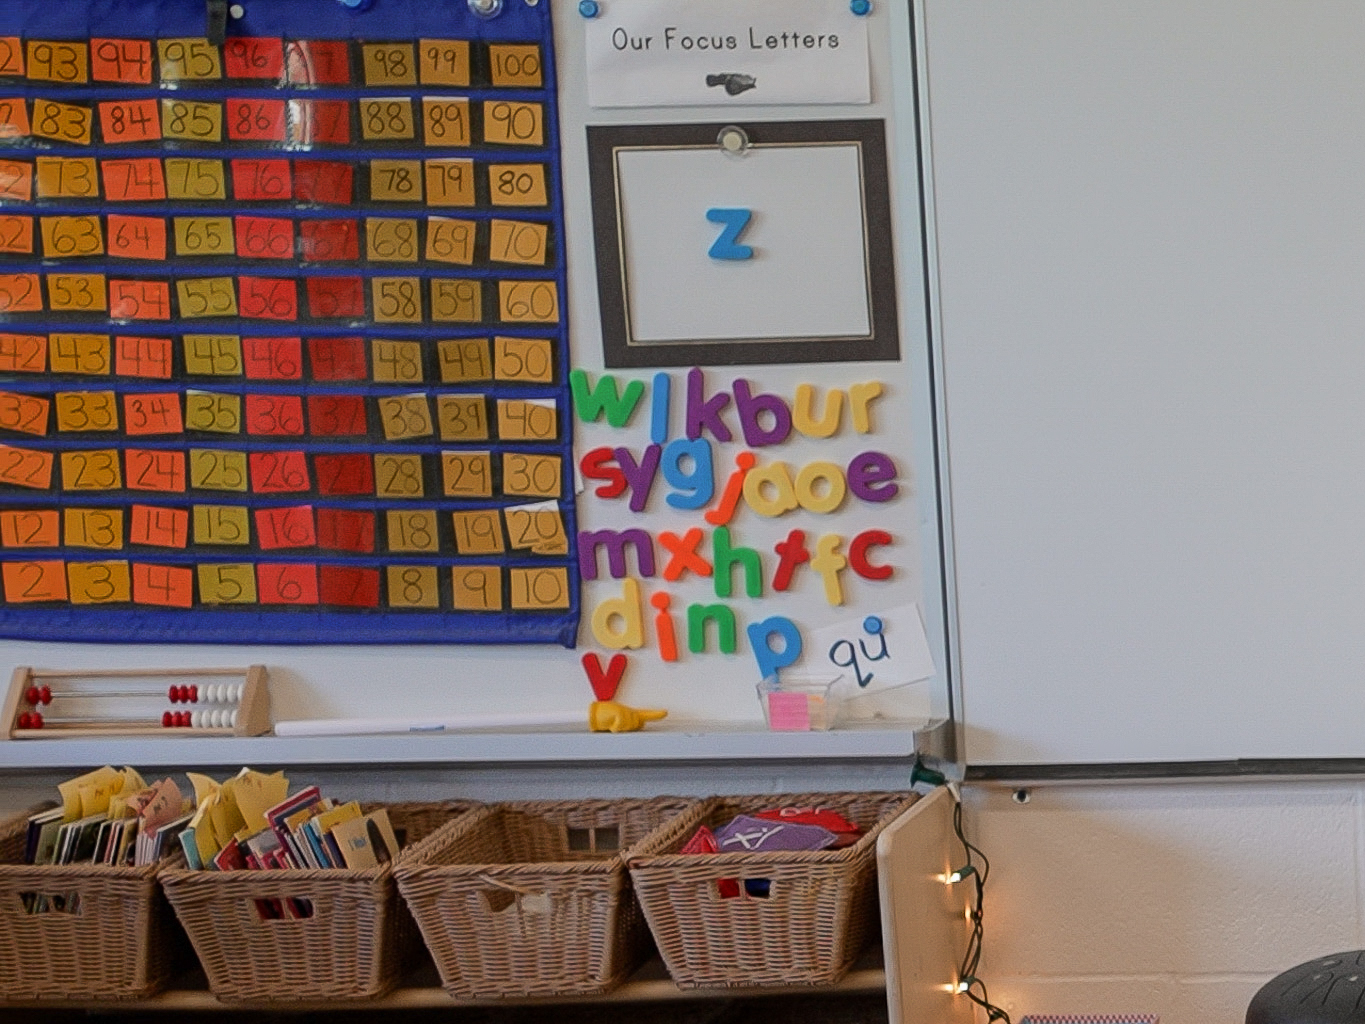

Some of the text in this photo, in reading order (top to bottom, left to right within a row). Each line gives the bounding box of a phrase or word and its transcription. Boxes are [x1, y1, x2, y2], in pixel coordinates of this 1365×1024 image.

[612, 27, 839, 50] Our Focus Letters
[0, 41, 18, 73] 2
[34, 45, 78, 80] 93
[97, 42, 147, 78] 94
[165, 42, 213, 76] 95
[228, 44, 267, 69] 96
[375, 49, 407, 76] 98
[428, 49, 456, 72] 99
[496, 52, 538, 76] 100
[42, 104, 86, 140] 83
[111, 105, 151, 135] 84
[171, 105, 214, 135] 85
[237, 105, 271, 134] 86
[367, 103, 406, 133] 88
[430, 105, 463, 140] 89
[493, 105, 535, 138] 90
[37, 162, 91, 193] 73
[107, 162, 161, 195] 74
[166, 162, 218, 193] 75
[240, 162, 282, 192] 76
[381, 170, 412, 190] 78
[429, 167, 462, 195] 79
[498, 171, 532, 195] 80
[53, 219, 99, 253] 63
[117, 224, 149, 249] 64
[186, 221, 221, 248] 65
[247, 217, 289, 254] 66
[372, 220, 413, 258] 68
[433, 223, 468, 259] 69
[496, 224, 539, 259] 70
[56, 278, 93, 307] 53
[118, 284, 165, 316] 54
[186, 286, 232, 313] 55
[251, 283, 291, 315] 56
[382, 282, 416, 317] 58
[437, 281, 475, 317] 59
[507, 285, 555, 318] 60
[58, 337, 104, 372] 43
[122, 340, 167, 374] 44
[194, 337, 238, 371] 45
[253, 340, 297, 375] 46
[379, 343, 416, 378] 48
[444, 342, 484, 375] 49
[503, 342, 548, 376] 50
[0, 395, 42, 431] 32
[64, 397, 114, 427] 33
[132, 399, 169, 427] 34
[194, 395, 236, 428] 35
[259, 397, 299, 432] 36
[384, 401, 429, 433] 38
[444, 402, 481, 432] 39
[506, 404, 552, 436] 40
[2, 451, 45, 482] 22
[73, 453, 116, 487] 23
[137, 452, 179, 488] 24
[200, 452, 243, 487] 25
[262, 452, 303, 489] 26
[382, 458, 419, 493] 28
[450, 456, 486, 490] 29
[511, 455, 555, 490] 30
[14, 511, 50, 544] 12
[81, 512, 114, 546] 13
[146, 509, 179, 543] 14
[207, 508, 240, 541] 15
[270, 514, 309, 544] 16
[401, 514, 430, 548] 18
[463, 515, 497, 548] 19
[512, 507, 558, 542] 20
[22, 565, 51, 596] 2
[85, 565, 115, 599] 3
[148, 568, 174, 599] 4
[217, 565, 240, 599] 5
[279, 567, 303, 599] 6
[402, 569, 423, 602] 8
[463, 572, 489, 606] 9
[525, 571, 561, 604] 10
